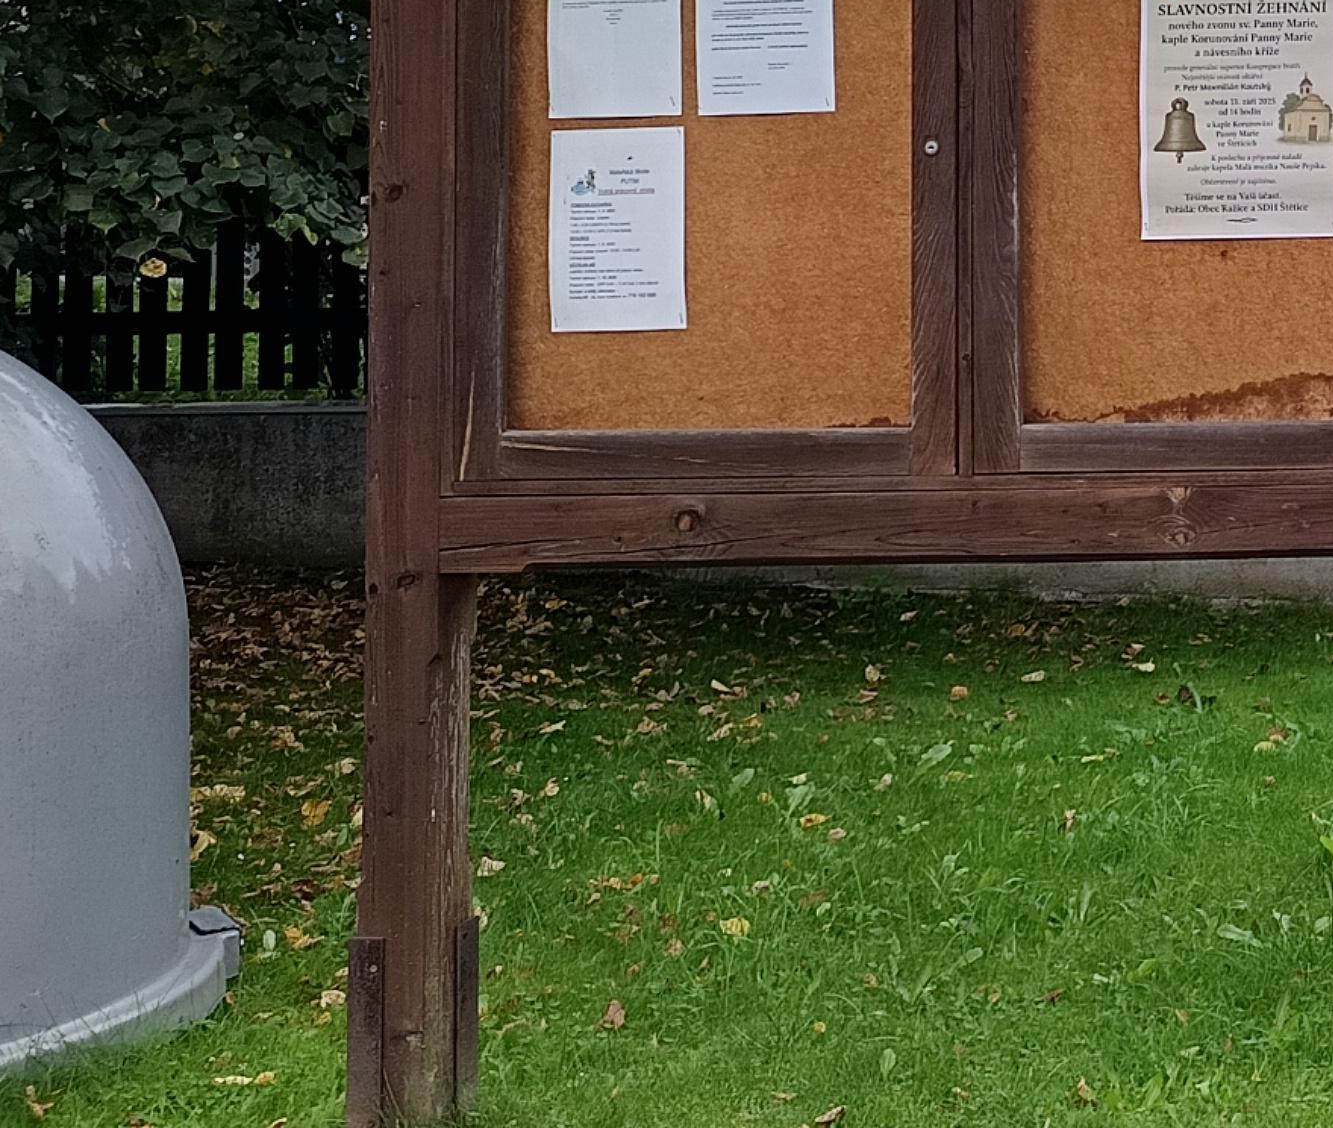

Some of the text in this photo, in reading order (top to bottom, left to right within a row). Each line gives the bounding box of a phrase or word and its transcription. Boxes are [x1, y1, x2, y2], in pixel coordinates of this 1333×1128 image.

[1158, 0, 1327, 17] SLAVNOSTNÍ ŽEHNÁNÍ
[1168, 20, 1204, 31] nového
[1207, 22, 1236, 30] zvonu
[1254, 19, 1284, 31] Panny
[1286, 18, 1319, 29] Marie,
[1161, 32, 1313, 46] kaple Korunování Panny Marie
[1203, 46, 1252, 57] návesního
[1255, 45, 1280, 56] kříže
[1198, 203, 1220, 213] Obec
